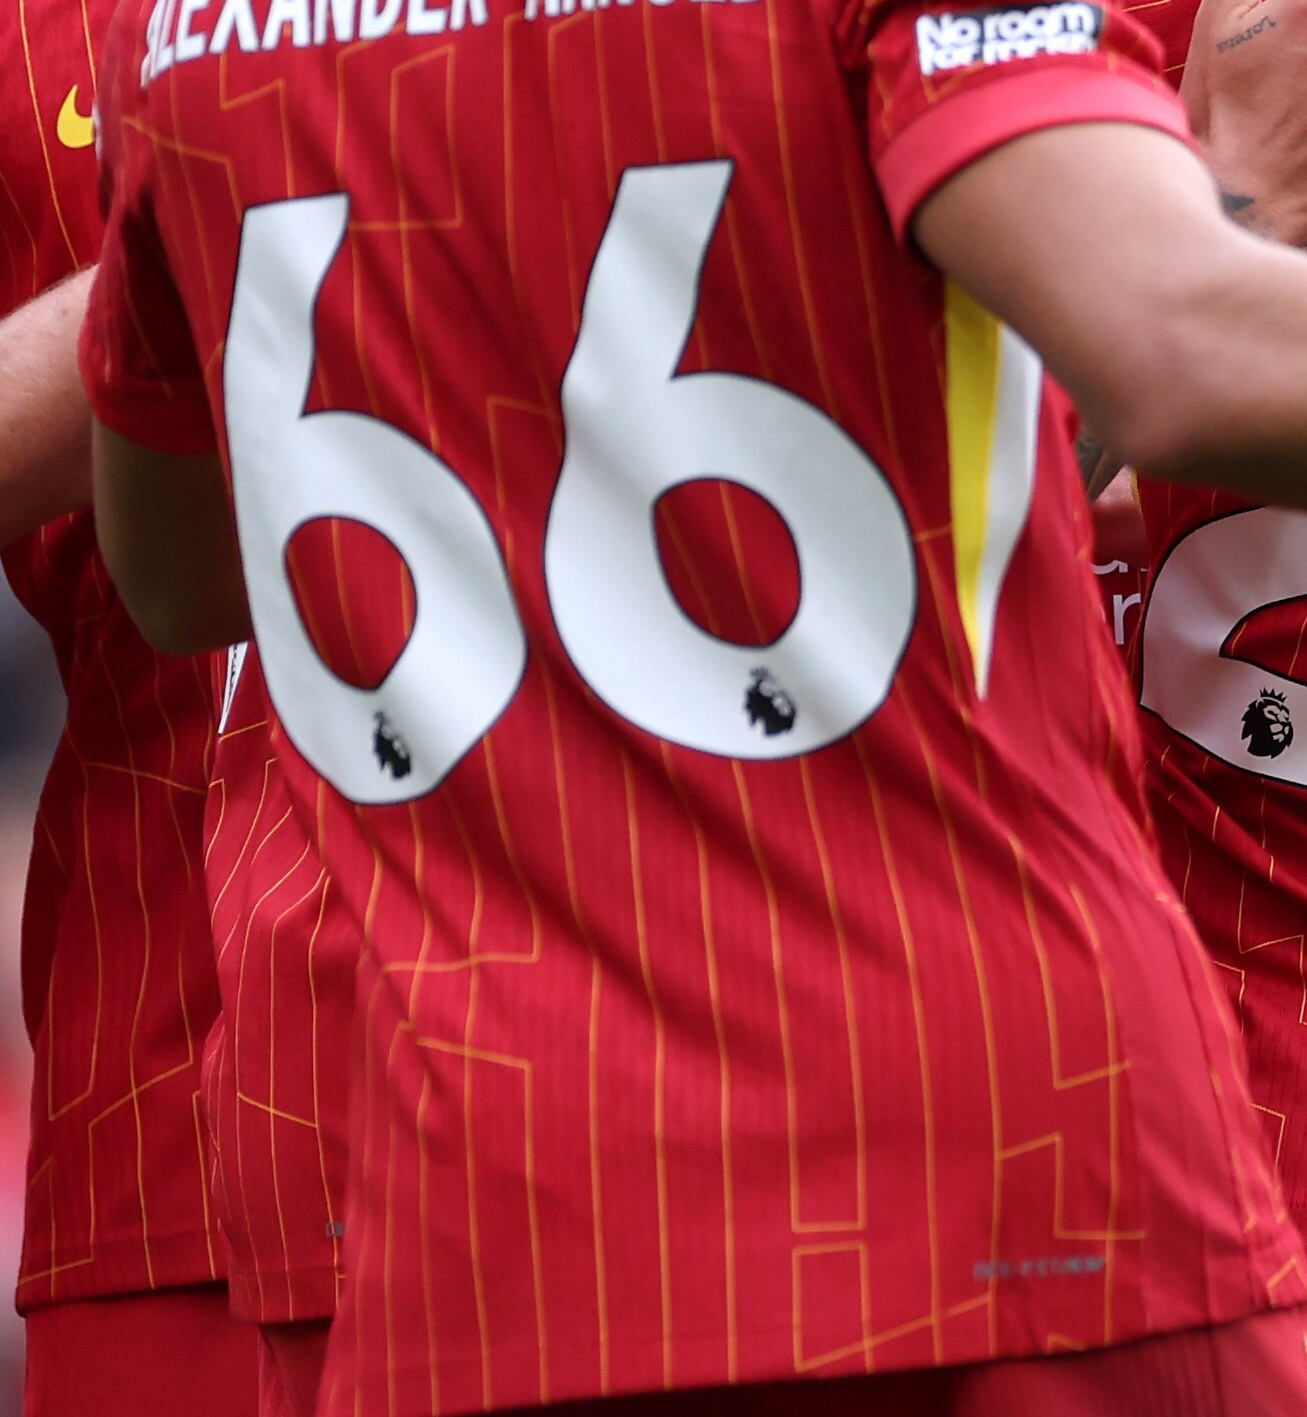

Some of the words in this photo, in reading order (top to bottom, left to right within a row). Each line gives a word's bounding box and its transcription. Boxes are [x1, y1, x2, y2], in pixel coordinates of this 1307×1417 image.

[916, 13, 980, 49] No
[983, 1, 1096, 42] room
[223, 159, 917, 805] 66
